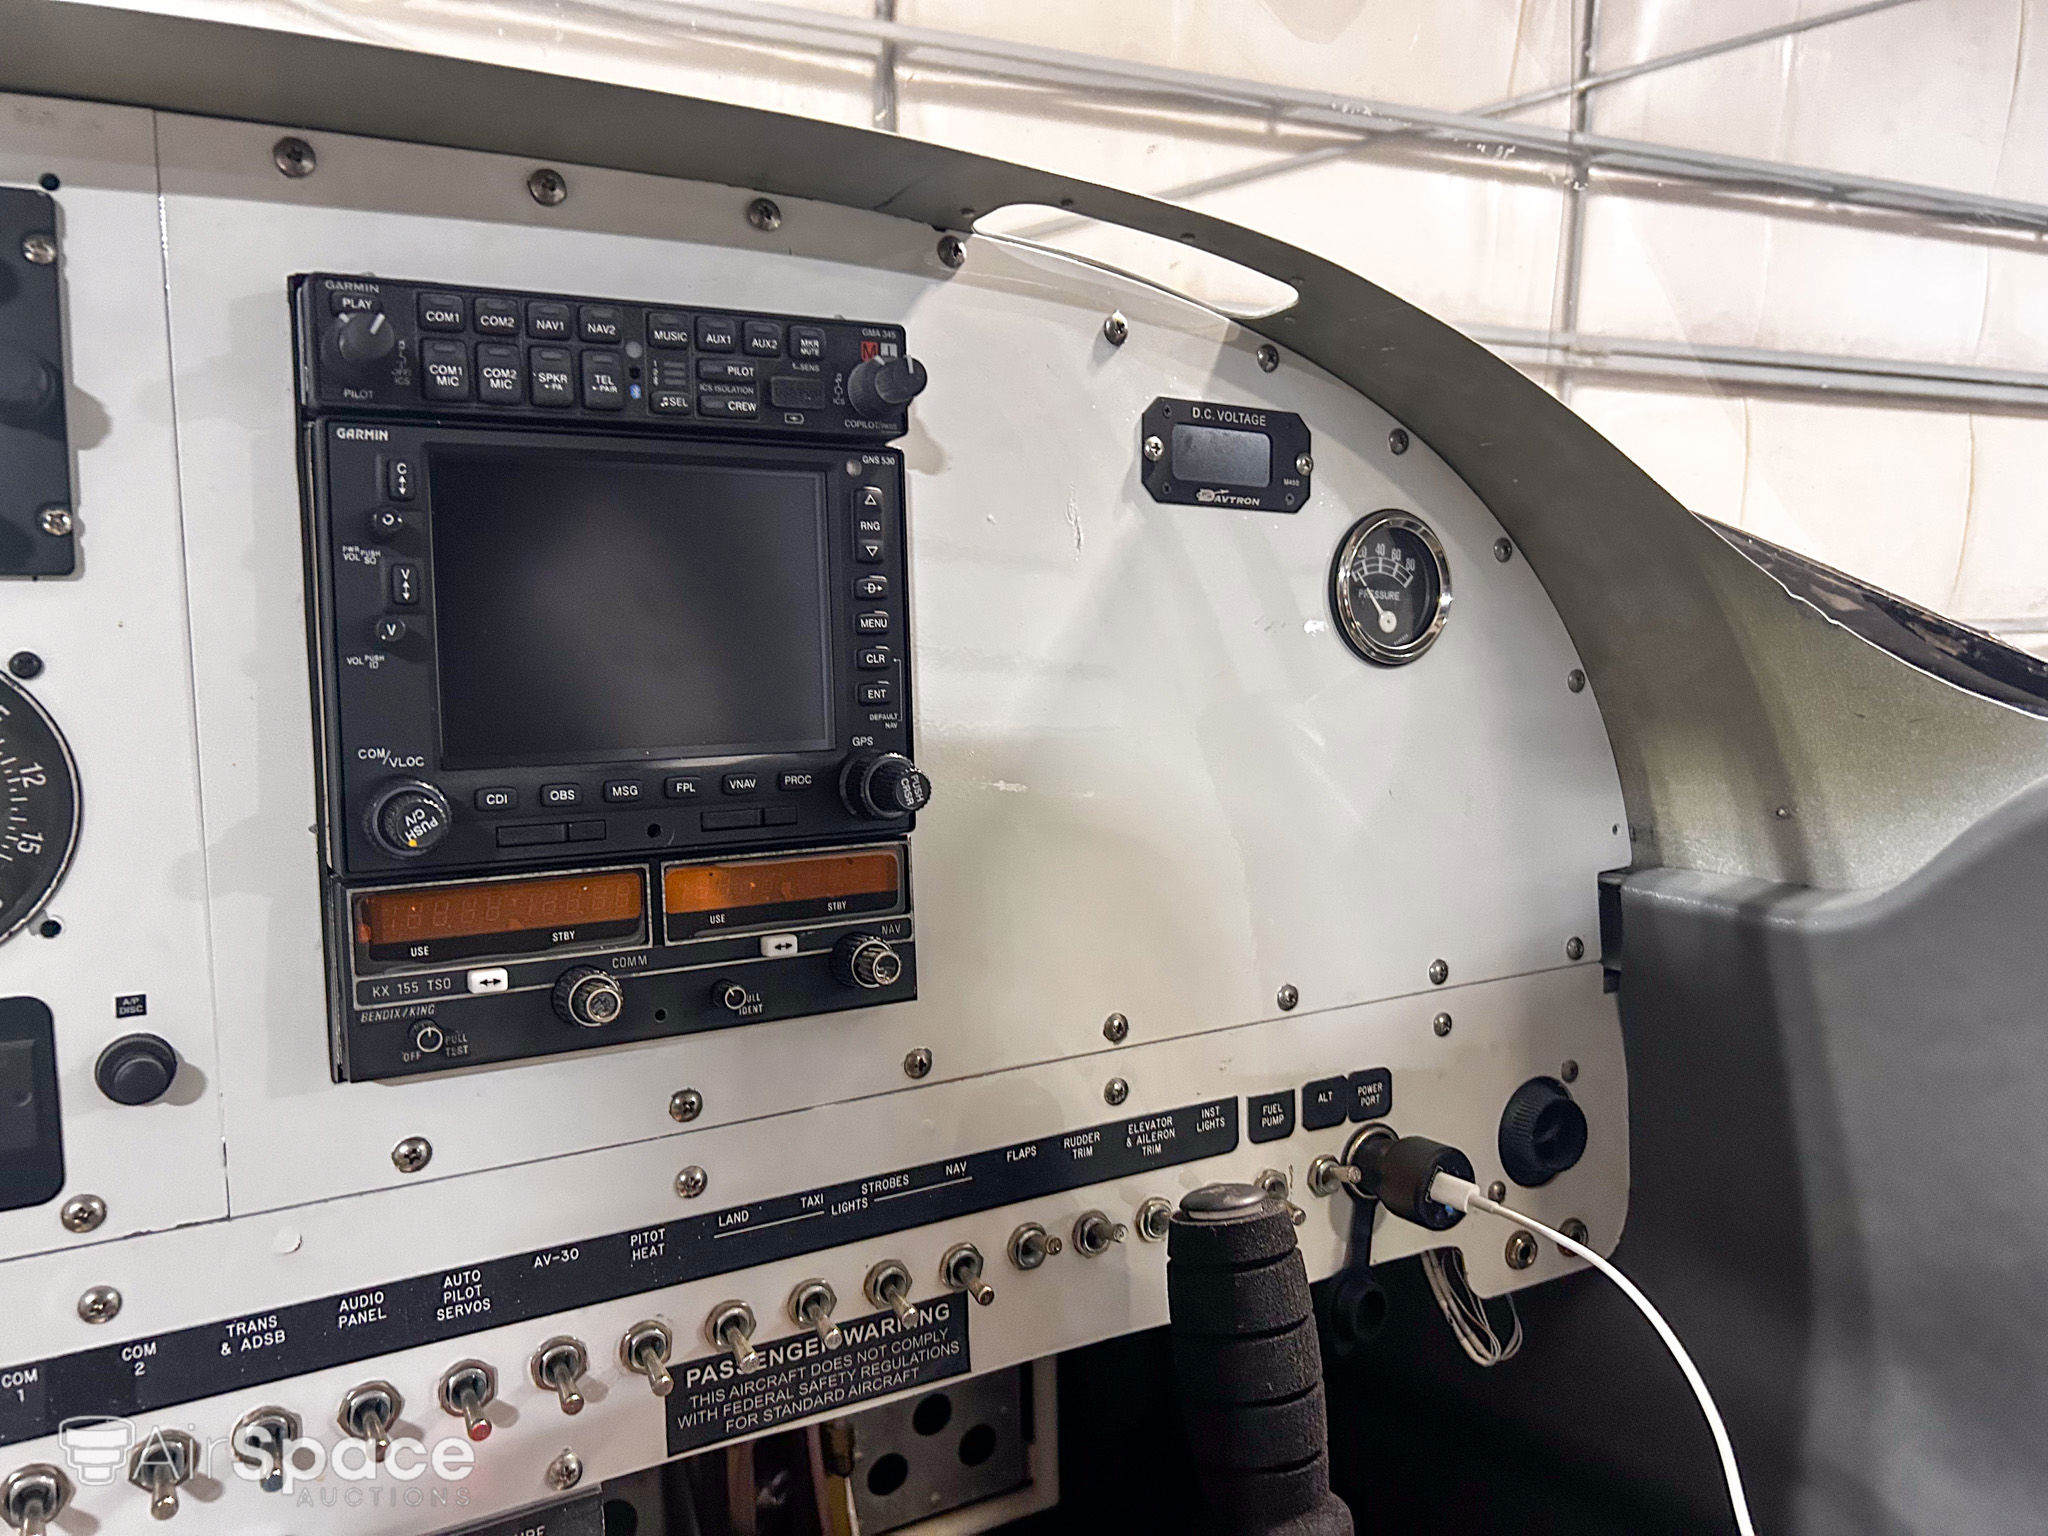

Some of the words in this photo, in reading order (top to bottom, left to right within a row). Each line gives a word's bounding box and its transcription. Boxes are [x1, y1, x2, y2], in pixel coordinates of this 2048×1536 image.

[325, 280, 379, 293] GARMIN
[342, 298, 373, 309] PLAY
[426, 311, 459, 323] COM1
[480, 314, 514, 327] COM2
[536, 320, 564, 331] NAV1
[587, 323, 616, 335] NAV2
[654, 330, 687, 342] MUSIC
[706, 333, 731, 345] AUX1
[751, 338, 777, 350] AUX2
[429, 364, 463, 376] COM1
[483, 367, 517, 380] COM2
[727, 366, 754, 377] PILOT
[437, 376, 459, 388] MIC
[490, 378, 513, 390] MIC
[538, 372, 568, 384] SPKR
[595, 374, 614, 386] TEL
[344, 388, 374, 399] PILOT
[670, 396, 688, 408] SEL
[727, 401, 757, 413] CREW
[1192, 407, 1215, 421] D.C.
[1216, 410, 1267, 427] VOLTAGE
[336, 428, 388, 441] GARMIN
[862, 455, 880, 465] GNS
[397, 463, 406, 474] C
[860, 521, 881, 532] RNG
[1375, 543, 1385, 556] 40
[1391, 548, 1401, 561] 60
[343, 552, 360, 562] VOL
[1405, 558, 1416, 571] 80
[401, 569, 410, 580] V
[387, 624, 396, 636] V
[860, 619, 888, 628] MENU
[346, 657, 364, 666] VOL
[369, 661, 379, 669] ID
[866, 654, 885, 664] CLR
[867, 689, 886, 699] ENT
[869, 713, 898, 721] DEFAULT
[852, 736, 874, 747] GPS
[19, 762, 47, 788] 12
[784, 775, 812, 786] PROC
[612, 785, 638, 797] MSG
[676, 783, 696, 794] FPL
[729, 779, 757, 790] VNAV
[910, 774, 925, 803] PUSH
[550, 789, 575, 801] OBS
[900, 777, 915, 806] CRSR
[486, 794, 508, 805] CDI
[404, 815, 439, 842] PUSH
[17, 832, 44, 855] 15
[827, 901, 847, 912] STBY
[709, 914, 726, 925] USE
[552, 930, 576, 942] STBY
[881, 924, 901, 935] NAV
[410, 946, 430, 958] USE
[612, 955, 648, 969] COMM
[372, 986, 391, 999] KX
[397, 982, 419, 996] 155
[427, 978, 451, 991] TSO
[122, 998, 139, 1006] A/P
[119, 1005, 144, 1015] DISC
[360, 1004, 435, 1023] BENDIX/KING
[739, 1003, 763, 1016] IDENT
[445, 1032, 468, 1045] PULL
[402, 1050, 422, 1063] OFF
[445, 1045, 469, 1058] TEST
[1357, 1082, 1383, 1097] POWER
[1317, 1091, 1333, 1104] ALT
[1360, 1095, 1381, 1107] PORT
[1201, 1105, 1220, 1119] INST
[1262, 1103, 1283, 1116] FUEL
[1128, 1116, 1173, 1135] ELEVATOR
[1196, 1116, 1226, 1133] LIGHTS
[1261, 1114, 1285, 1128] PUMP
[1063, 1131, 1101, 1149] RUDDER
[1126, 1137, 1133, 1148] &
[1135, 1128, 1176, 1146] AILERON
[1006, 1145, 1037, 1162] FLAPS
[1072, 1145, 1093, 1160] TRIM
[1142, 1143, 1162, 1157] TRIM
[945, 1161, 967, 1177] NAV
[861, 1174, 910, 1195] STROBES
[800, 1193, 825, 1209] TAXI
[831, 1198, 869, 1216] LIGHTS
[718, 1210, 749, 1228] LAND
[630, 1228, 666, 1247] PITOT
[533, 1248, 580, 1269] AV-30
[632, 1243, 666, 1262] HEAT
[443, 1269, 482, 1290] AUTO
[443, 1284, 483, 1305] PILOT
[339, 1291, 385, 1313] AUDIO
[436, 1297, 491, 1322] SERVOS
[338, 1309, 387, 1329] PANEL
[226, 1315, 279, 1338] TRANS
[220, 1342, 232, 1356] &
[240, 1330, 286, 1351] ADSB
[686, 1336, 828, 1389] PASENGE
[843, 1303, 950, 1347] WARNG
[121, 1342, 157, 1362] COM
[134, 1362, 146, 1376] 2
[690, 1389, 726, 1410] THIS
[729, 1366, 807, 1399] AIRCRAFT
[810, 1356, 853, 1378] DOES
[857, 1345, 888, 1366] NOT
[890, 1327, 950, 1357] COMPLY
[1, 1368, 38, 1388] COM
[678, 1408, 719, 1430] WITH
[723, 1387, 795, 1418] FEDERAL
[798, 1371, 857, 1396] SAFETY
[860, 1341, 960, 1380] REGULATIONS
[17, 1389, 25, 1403] 1
[725, 1414, 759, 1434] FOR
[763, 1390, 845, 1423] STANDARD
[847, 1366, 920, 1398] AIRCRAFT
